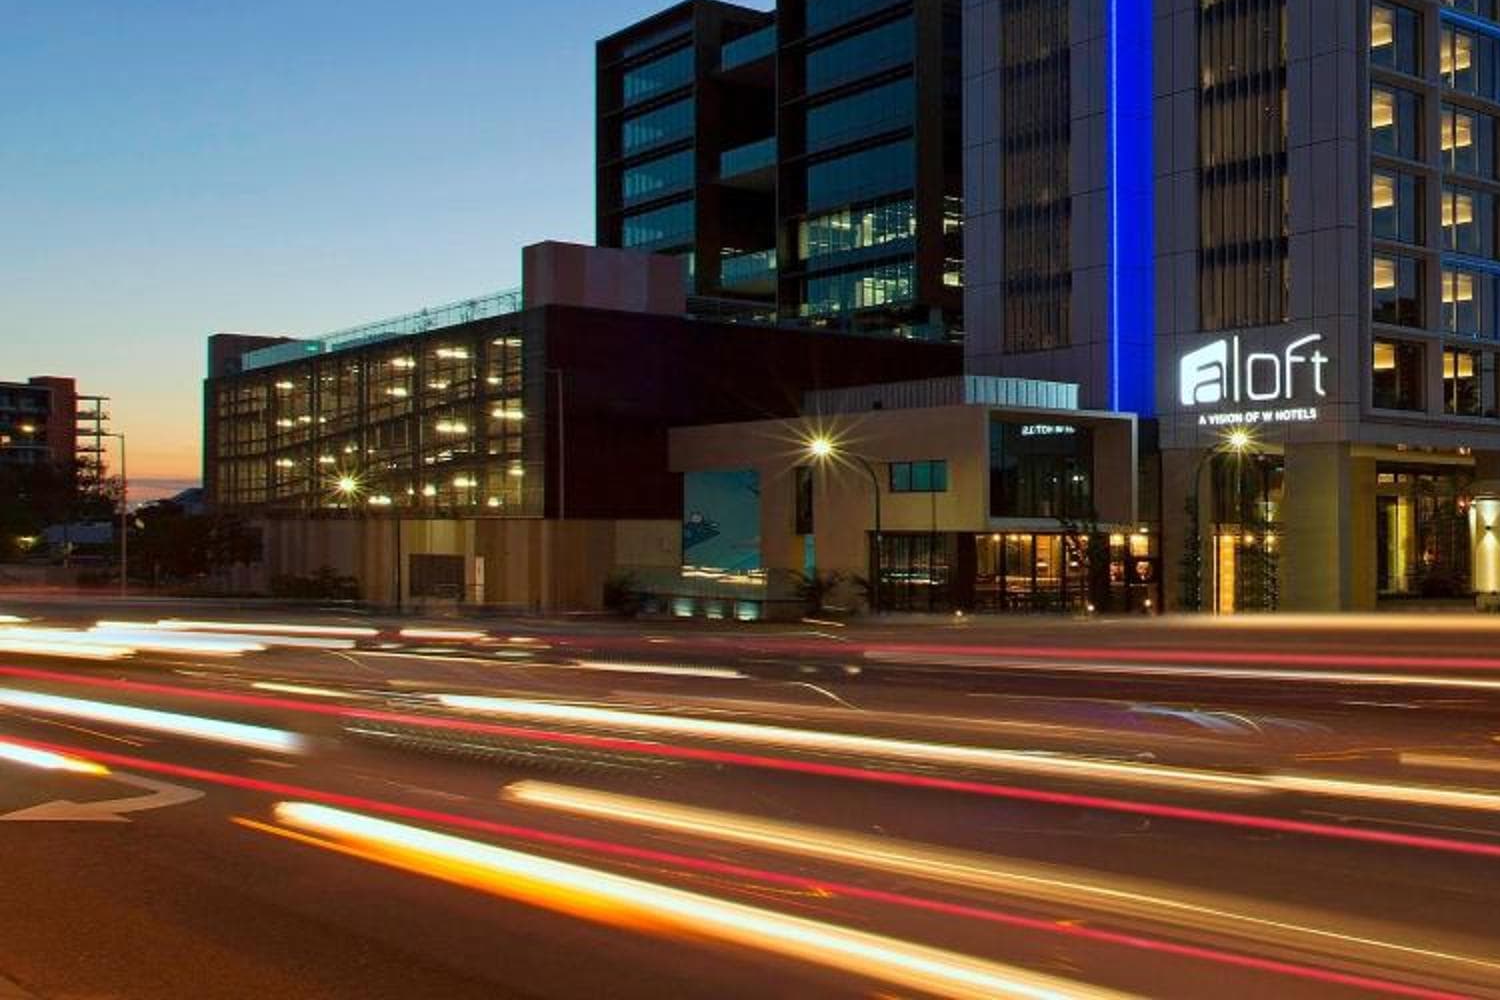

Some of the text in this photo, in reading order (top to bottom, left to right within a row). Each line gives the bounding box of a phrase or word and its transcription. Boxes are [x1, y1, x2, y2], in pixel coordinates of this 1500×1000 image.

[1180, 333, 1329, 406] aloft
[1199, 408, 1317, 425] A VISION OF W HOTELS
